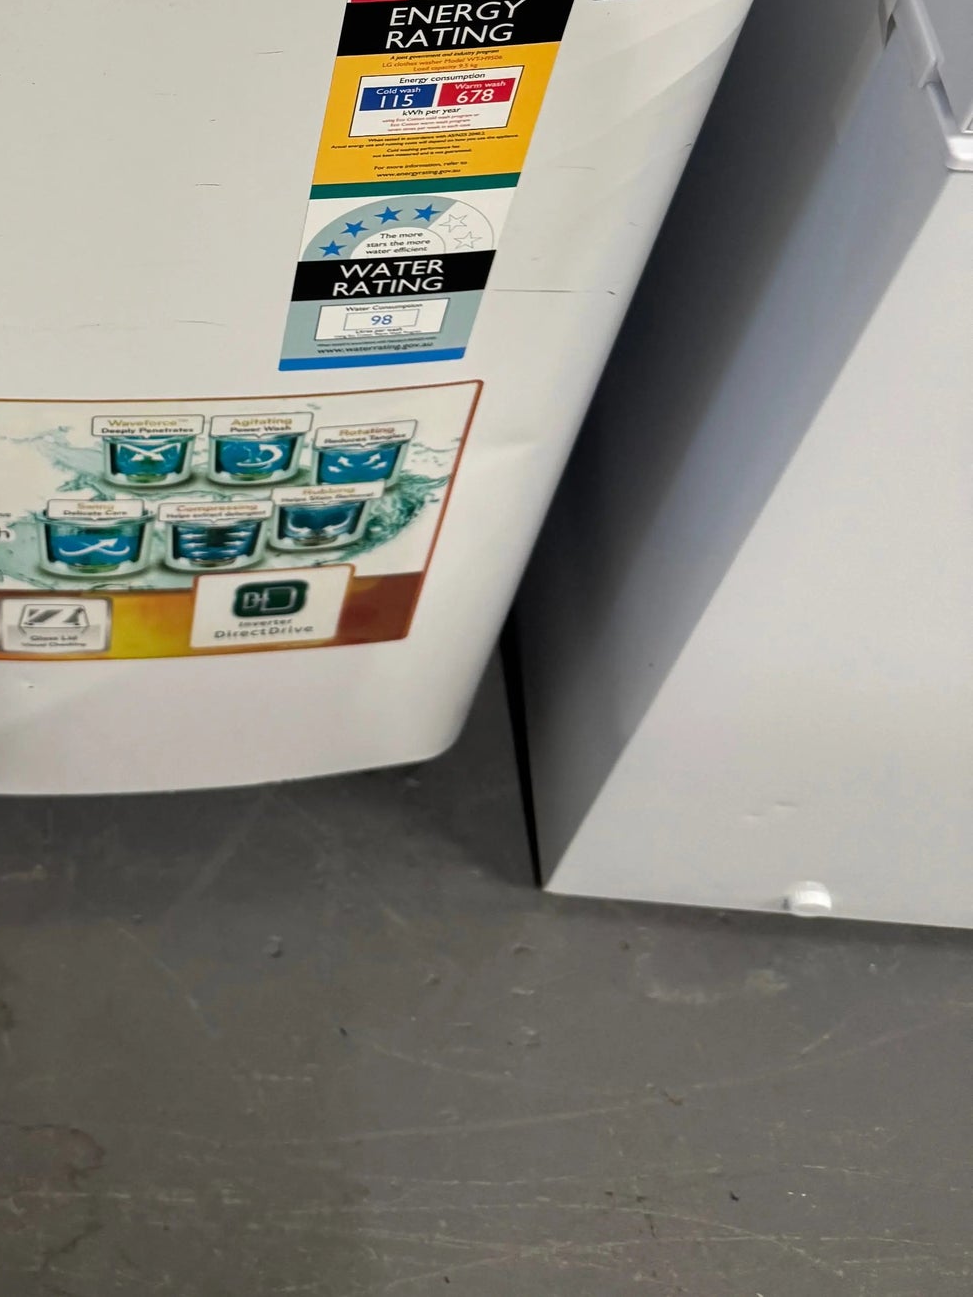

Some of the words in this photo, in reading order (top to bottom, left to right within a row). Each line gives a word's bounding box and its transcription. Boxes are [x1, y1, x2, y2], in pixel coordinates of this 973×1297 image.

[389, 0, 526, 27] ENERGY
[385, 23, 515, 49] RATING
[399, 77, 429, 85] Energy
[430, 73, 486, 82] consumption
[455, 82, 483, 90] Warm
[380, 94, 415, 109] 115
[456, 89, 495, 104] 678
[340, 259, 444, 279] WATER
[332, 276, 444, 297] RATING
[371, 314, 393, 326] 98
[231, 417, 293, 427] Agitating
[339, 427, 395, 436] Rotating
[238, 618, 292, 628] Inverter
